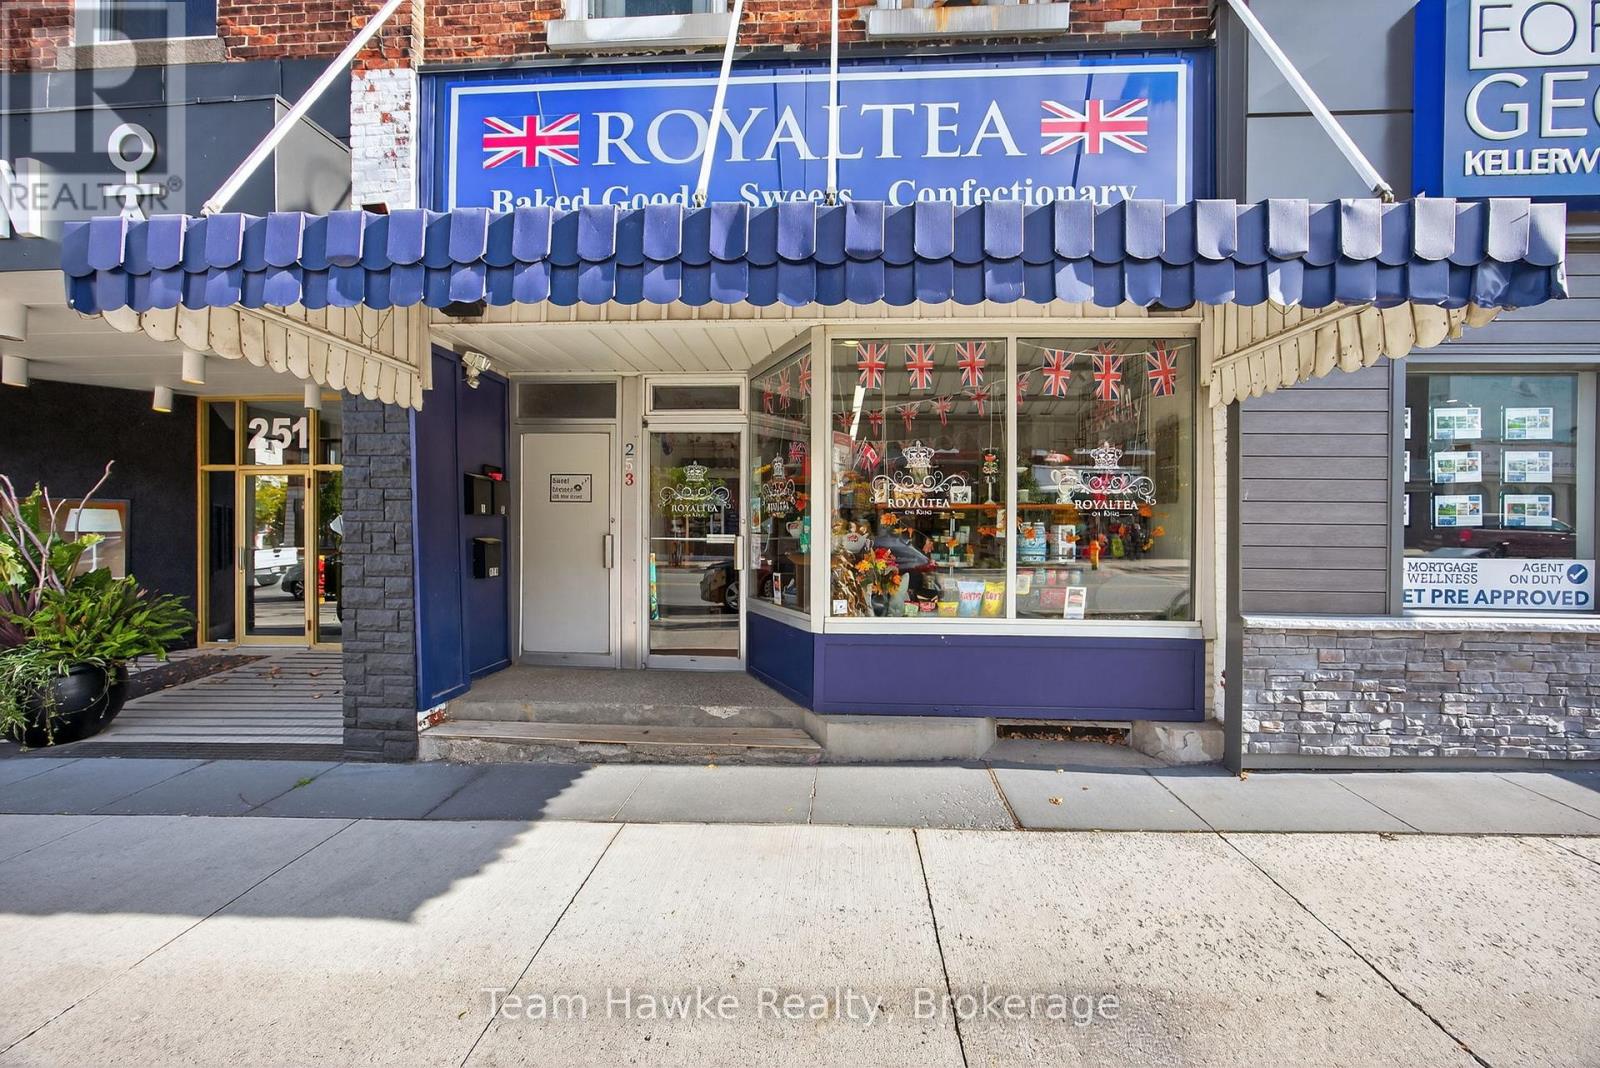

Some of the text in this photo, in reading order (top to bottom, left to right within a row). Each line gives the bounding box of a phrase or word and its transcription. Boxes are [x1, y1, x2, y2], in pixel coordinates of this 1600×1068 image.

[1465, 71, 1600, 141] GE
[591, 99, 1027, 166] ROYALTEA
[1465, 147, 1600, 176] KELLERW
[490, 187, 590, 213] Baked
[248, 417, 307, 449] 251
[887, 498, 951, 508] ROYALTEA
[1074, 499, 1139, 510] ROYALTEA
[1407, 562, 1478, 573] MORTGAGE
[1522, 563, 1564, 573] AGENT
[1407, 573, 1478, 584] WELLNESS
[1509, 575, 1564, 585] ON DUTY
[1431, 589, 1469, 604] PRE
[1473, 590, 1590, 606] APPROVED
